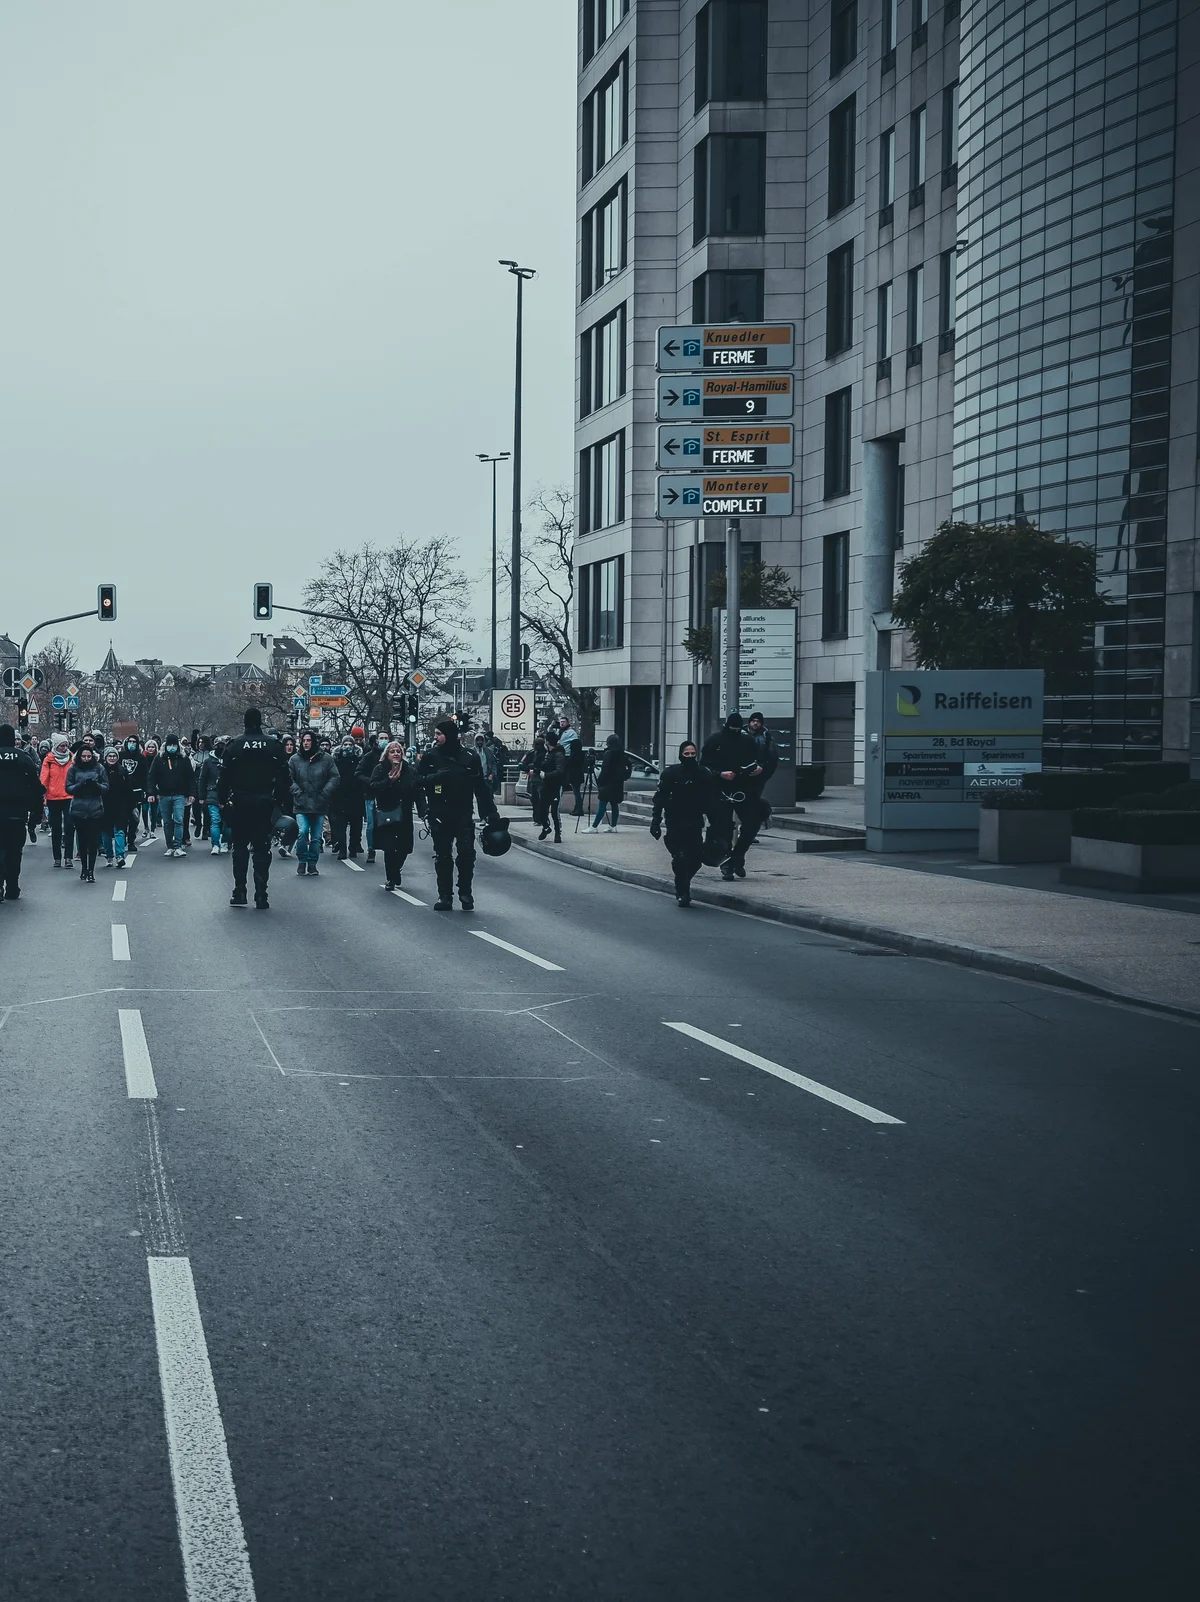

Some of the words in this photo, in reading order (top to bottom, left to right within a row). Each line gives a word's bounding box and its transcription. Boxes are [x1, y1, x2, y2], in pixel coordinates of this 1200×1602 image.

[706, 331, 766, 343] Knuedler
[713, 350, 755, 364] FERME
[706, 381, 788, 394] Royal-Hamilius
[745, 400, 755, 413] 9
[706, 431, 724, 442] St.
[731, 431, 770, 444] Esprit
[712, 450, 755, 463] FERME
[705, 481, 768, 492] Monterey
[703, 499, 763, 513] COMPLET
[934, 691, 1033, 710] Raiffeisen
[501, 722, 526, 730] ICBC
[933, 738, 947, 748] 28,
[951, 738, 964, 746] Bd
[967, 738, 996, 748] Royal
[903, 752, 947, 760] Sparinvest
[981, 751, 1024, 760] Sparinvest
